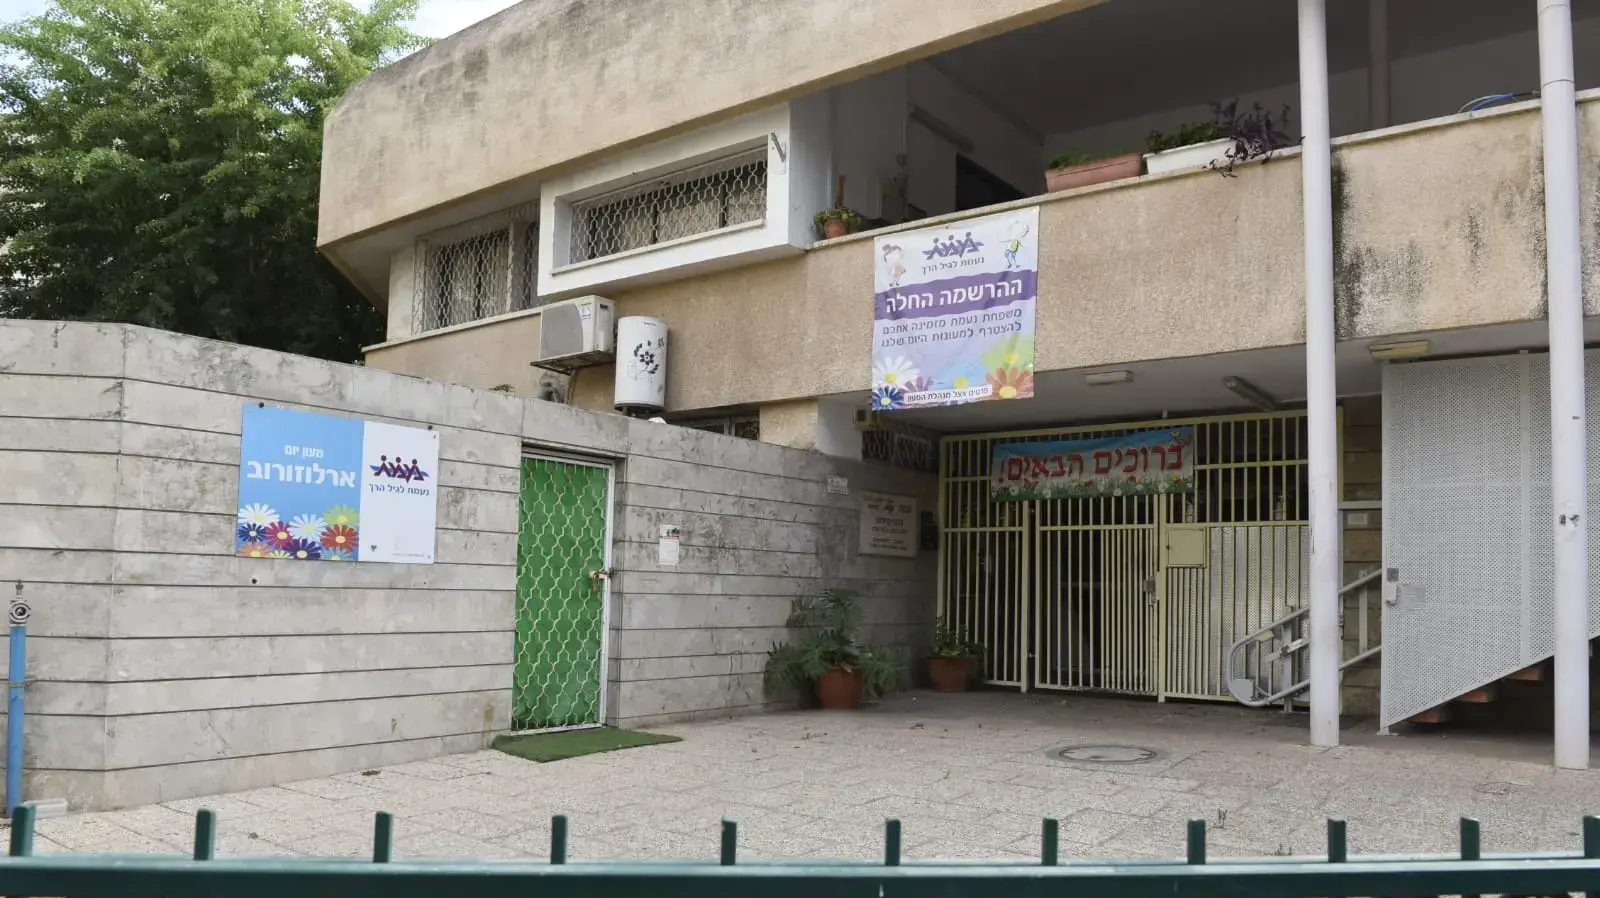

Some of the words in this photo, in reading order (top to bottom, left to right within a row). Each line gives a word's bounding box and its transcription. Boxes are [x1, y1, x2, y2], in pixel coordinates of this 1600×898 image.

[939, 260, 958, 271] לגיל
[961, 256, 985, 267] נעמת
[921, 265, 937, 275] הרך
[939, 279, 1022, 306] ההרשמה
[886, 292, 933, 313] החלה
[950, 315, 977, 327] נעמת
[982, 308, 1022, 323] משפחת
[883, 323, 908, 335] אתכם
[911, 319, 946, 331] מזמינה
[979, 321, 1022, 338] להצטרף
[908, 334, 928, 344] היום
[931, 328, 974, 342] למעונות
[881, 338, 904, 347] שלנו
[284, 444, 299, 456] יום
[302, 447, 324, 459] מעון
[1092, 444, 1184, 475] ברוכים
[999, 452, 1084, 482] הבאים!
[247, 460, 356, 488] ארלוזורוב
[369, 483, 385, 493] הרך
[387, 484, 405, 494] לגיל
[407, 487, 430, 496] נעמת
